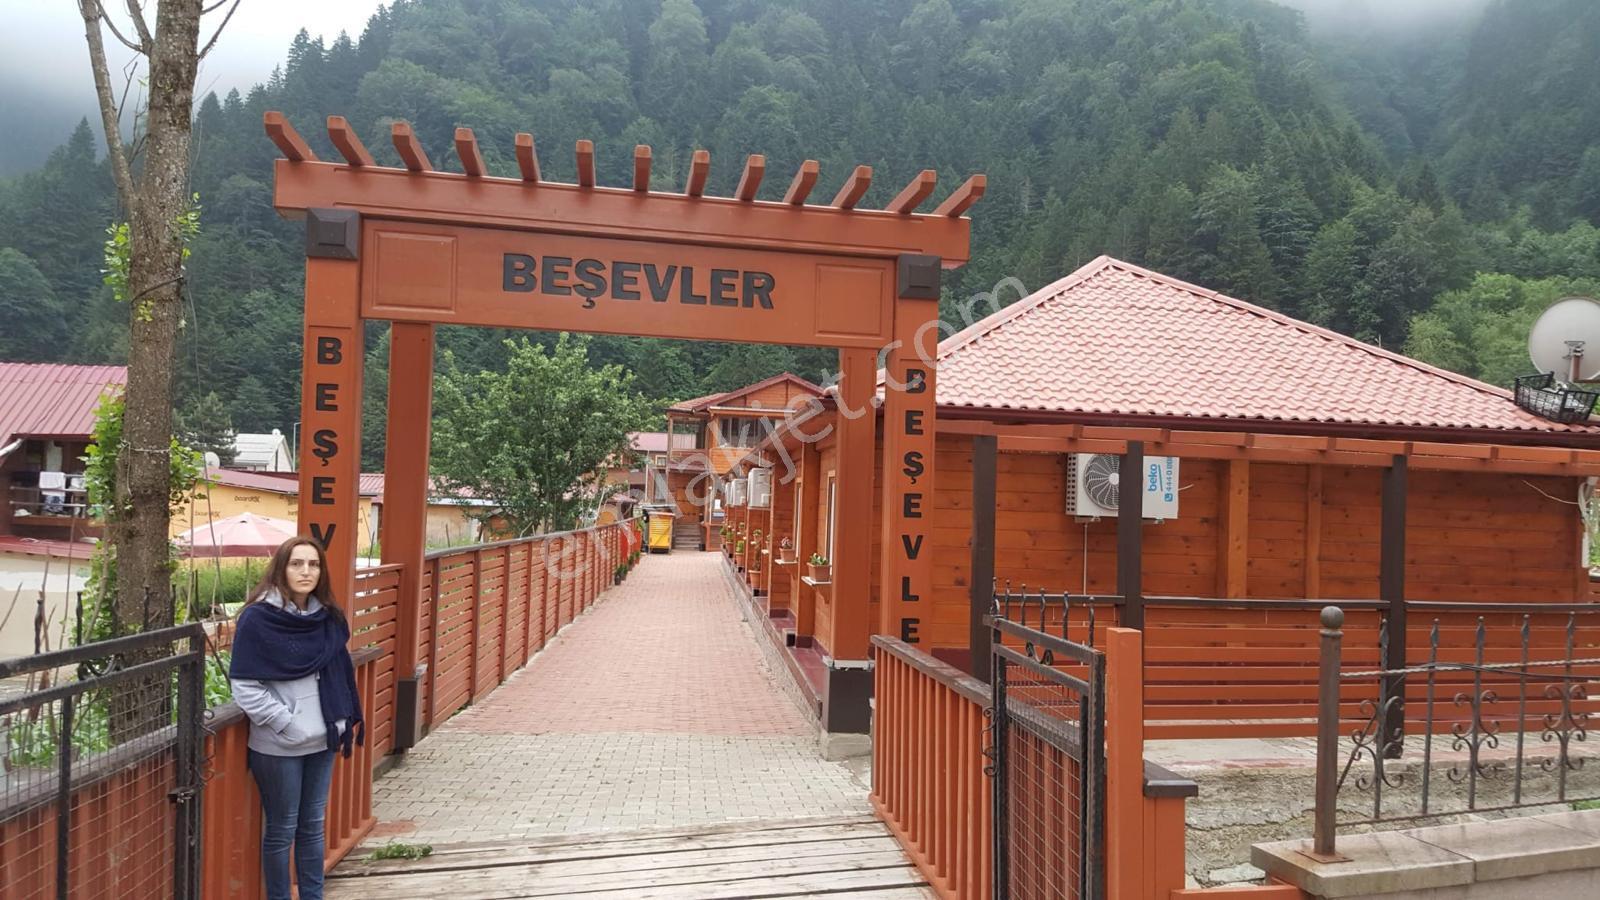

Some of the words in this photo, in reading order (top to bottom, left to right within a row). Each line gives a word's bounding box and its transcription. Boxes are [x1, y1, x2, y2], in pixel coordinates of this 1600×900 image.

[503, 253, 776, 309] BEŞEVLER
[309, 336, 343, 552] BEŞEV
[901, 368, 927, 644] BEŞEVLE
[1147, 464, 1157, 491] beko
